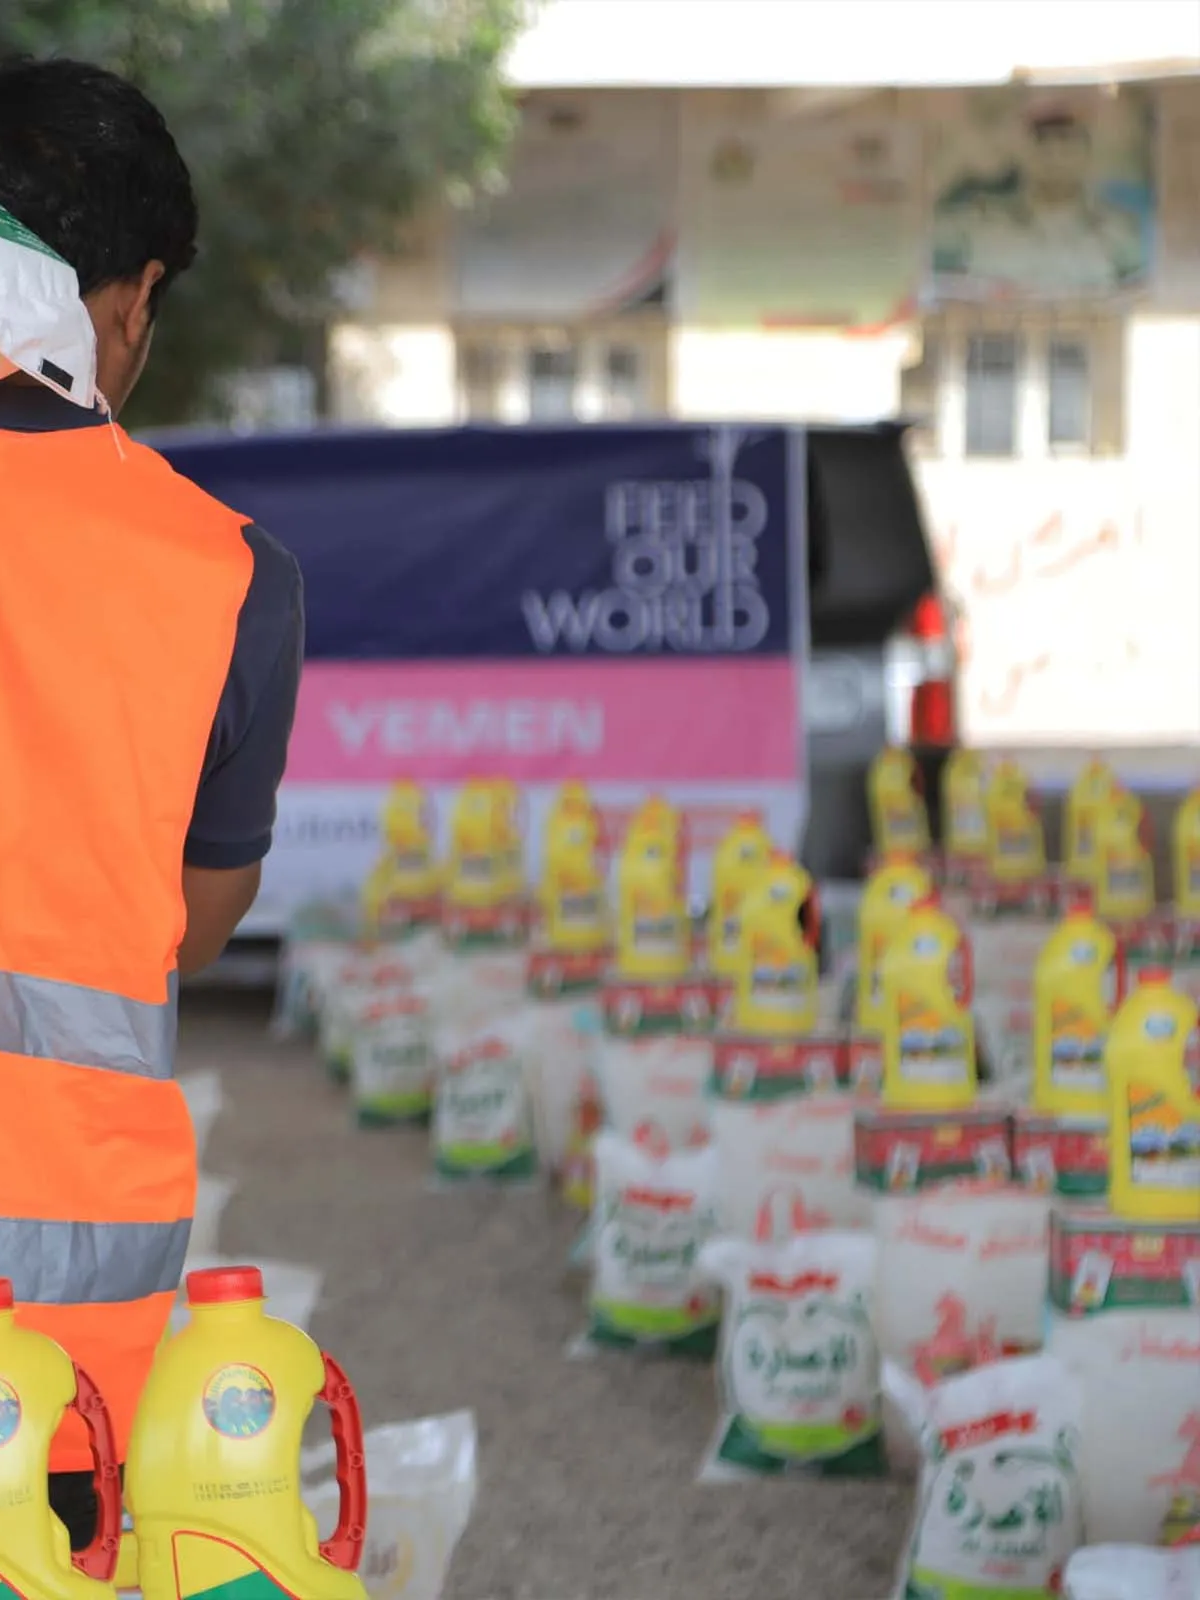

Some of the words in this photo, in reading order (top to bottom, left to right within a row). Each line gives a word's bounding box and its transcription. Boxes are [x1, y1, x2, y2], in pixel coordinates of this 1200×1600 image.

[604, 479, 768, 545] FEED
[611, 533, 762, 600] OUR
[520, 587, 770, 653] WORLD
[327, 702, 603, 758] YEMEN
